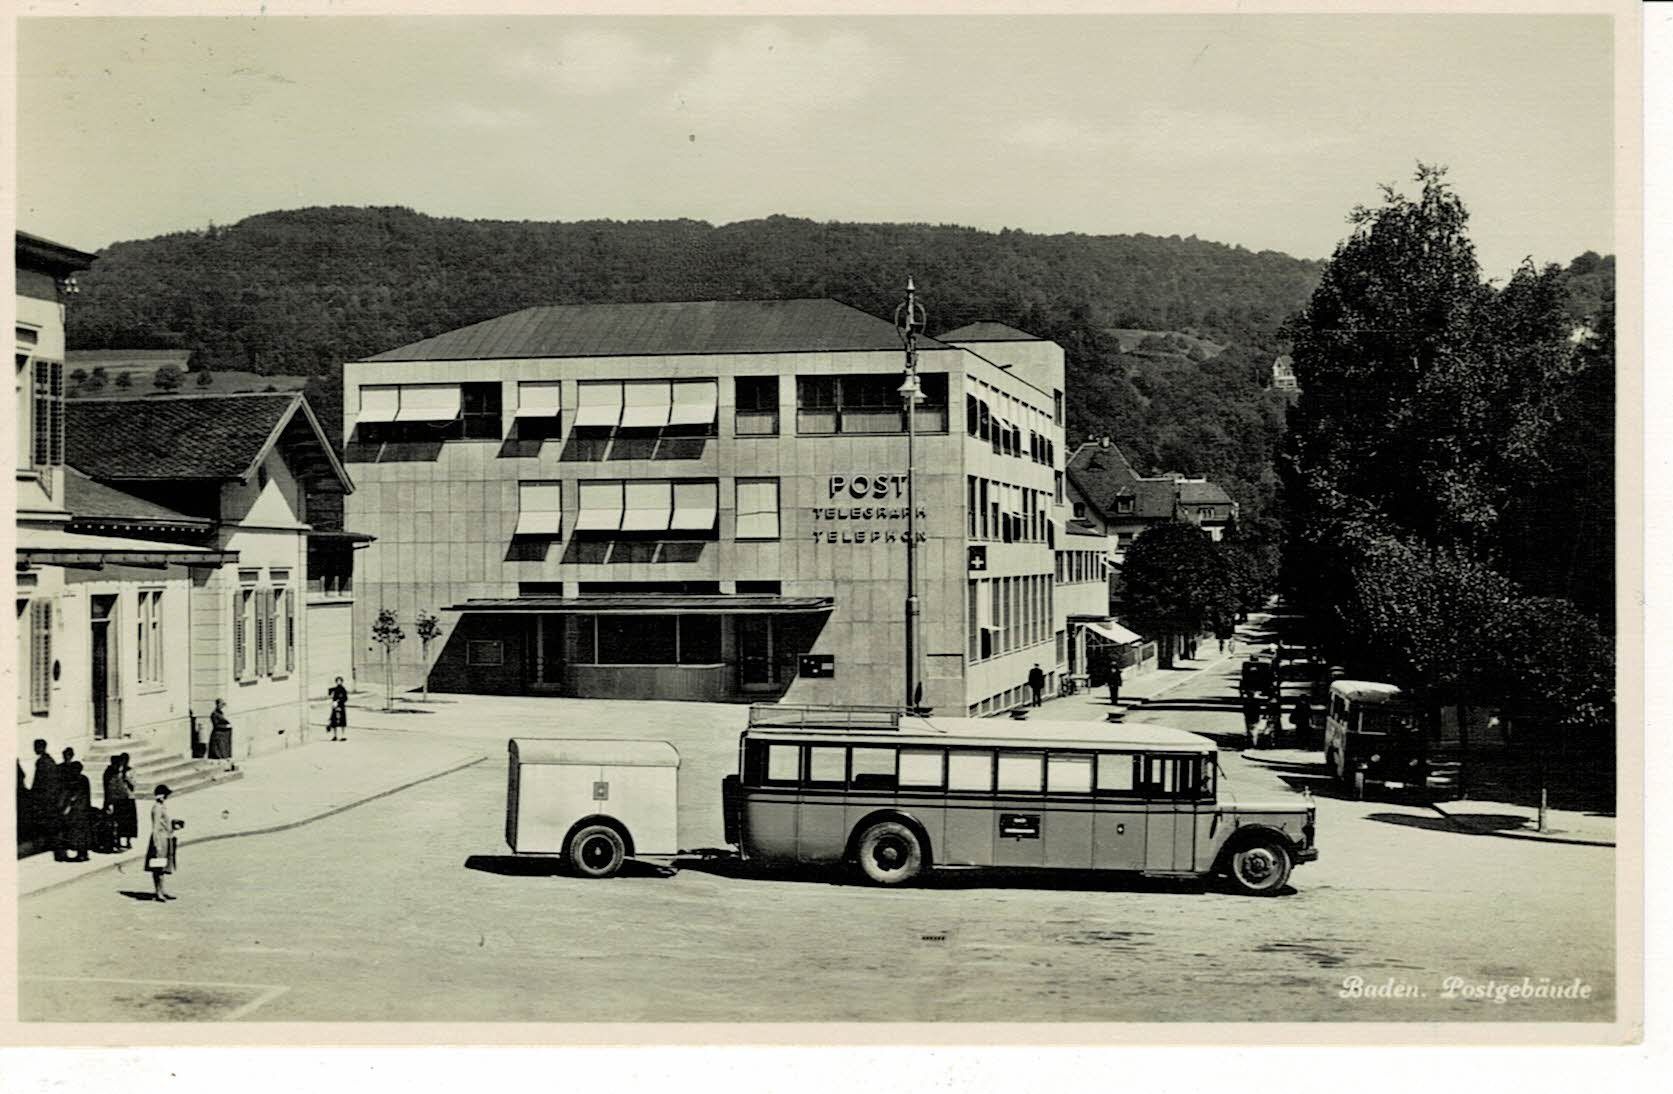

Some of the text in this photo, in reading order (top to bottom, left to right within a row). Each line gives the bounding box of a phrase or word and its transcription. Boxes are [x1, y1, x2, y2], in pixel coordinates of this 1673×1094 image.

[829, 475, 909, 499] POST
[812, 507, 926, 520] TELEGRAPH
[812, 531, 927, 544] TELEPHON
